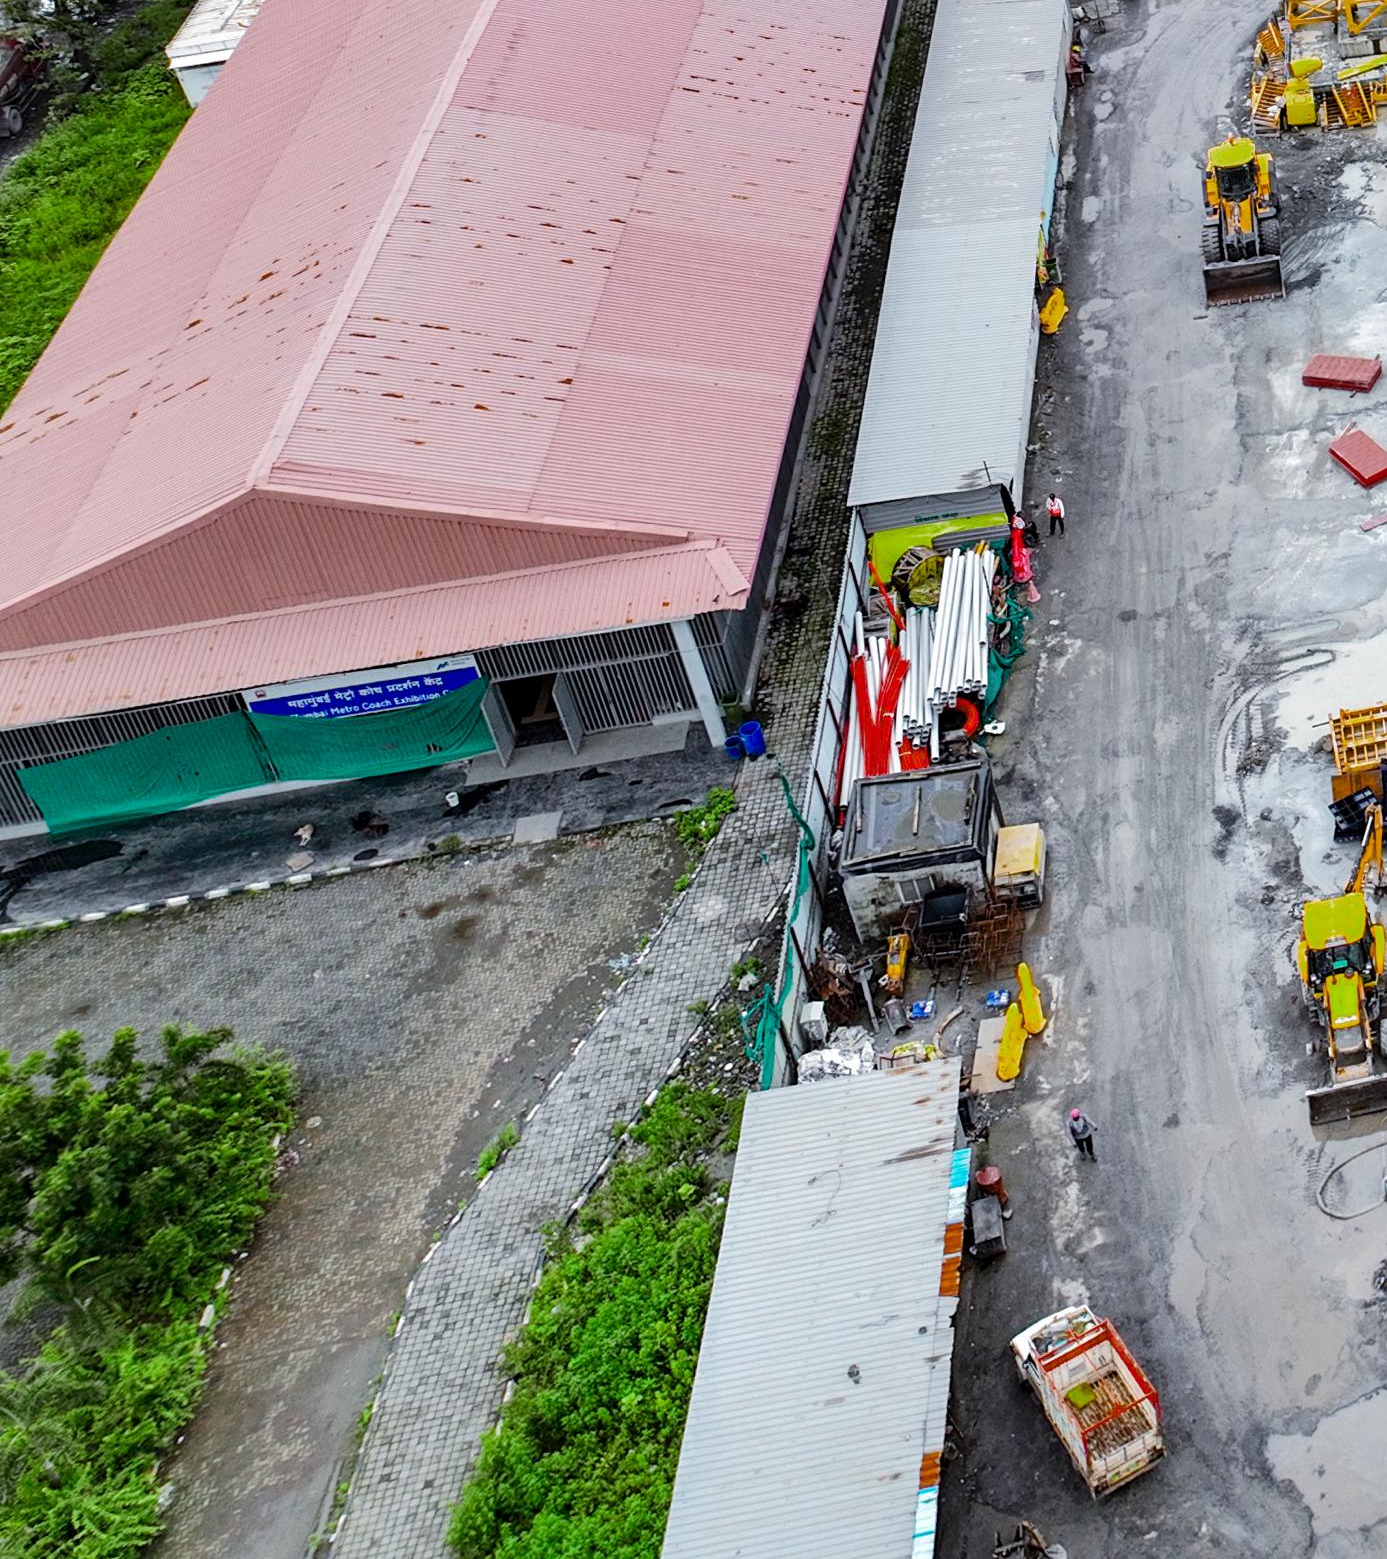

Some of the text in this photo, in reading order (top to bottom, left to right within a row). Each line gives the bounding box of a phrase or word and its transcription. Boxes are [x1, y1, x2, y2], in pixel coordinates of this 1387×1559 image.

[330, 704, 360, 716] Metro
[361, 698, 392, 712] Coach
[394, 691, 441, 708] Exhibition
